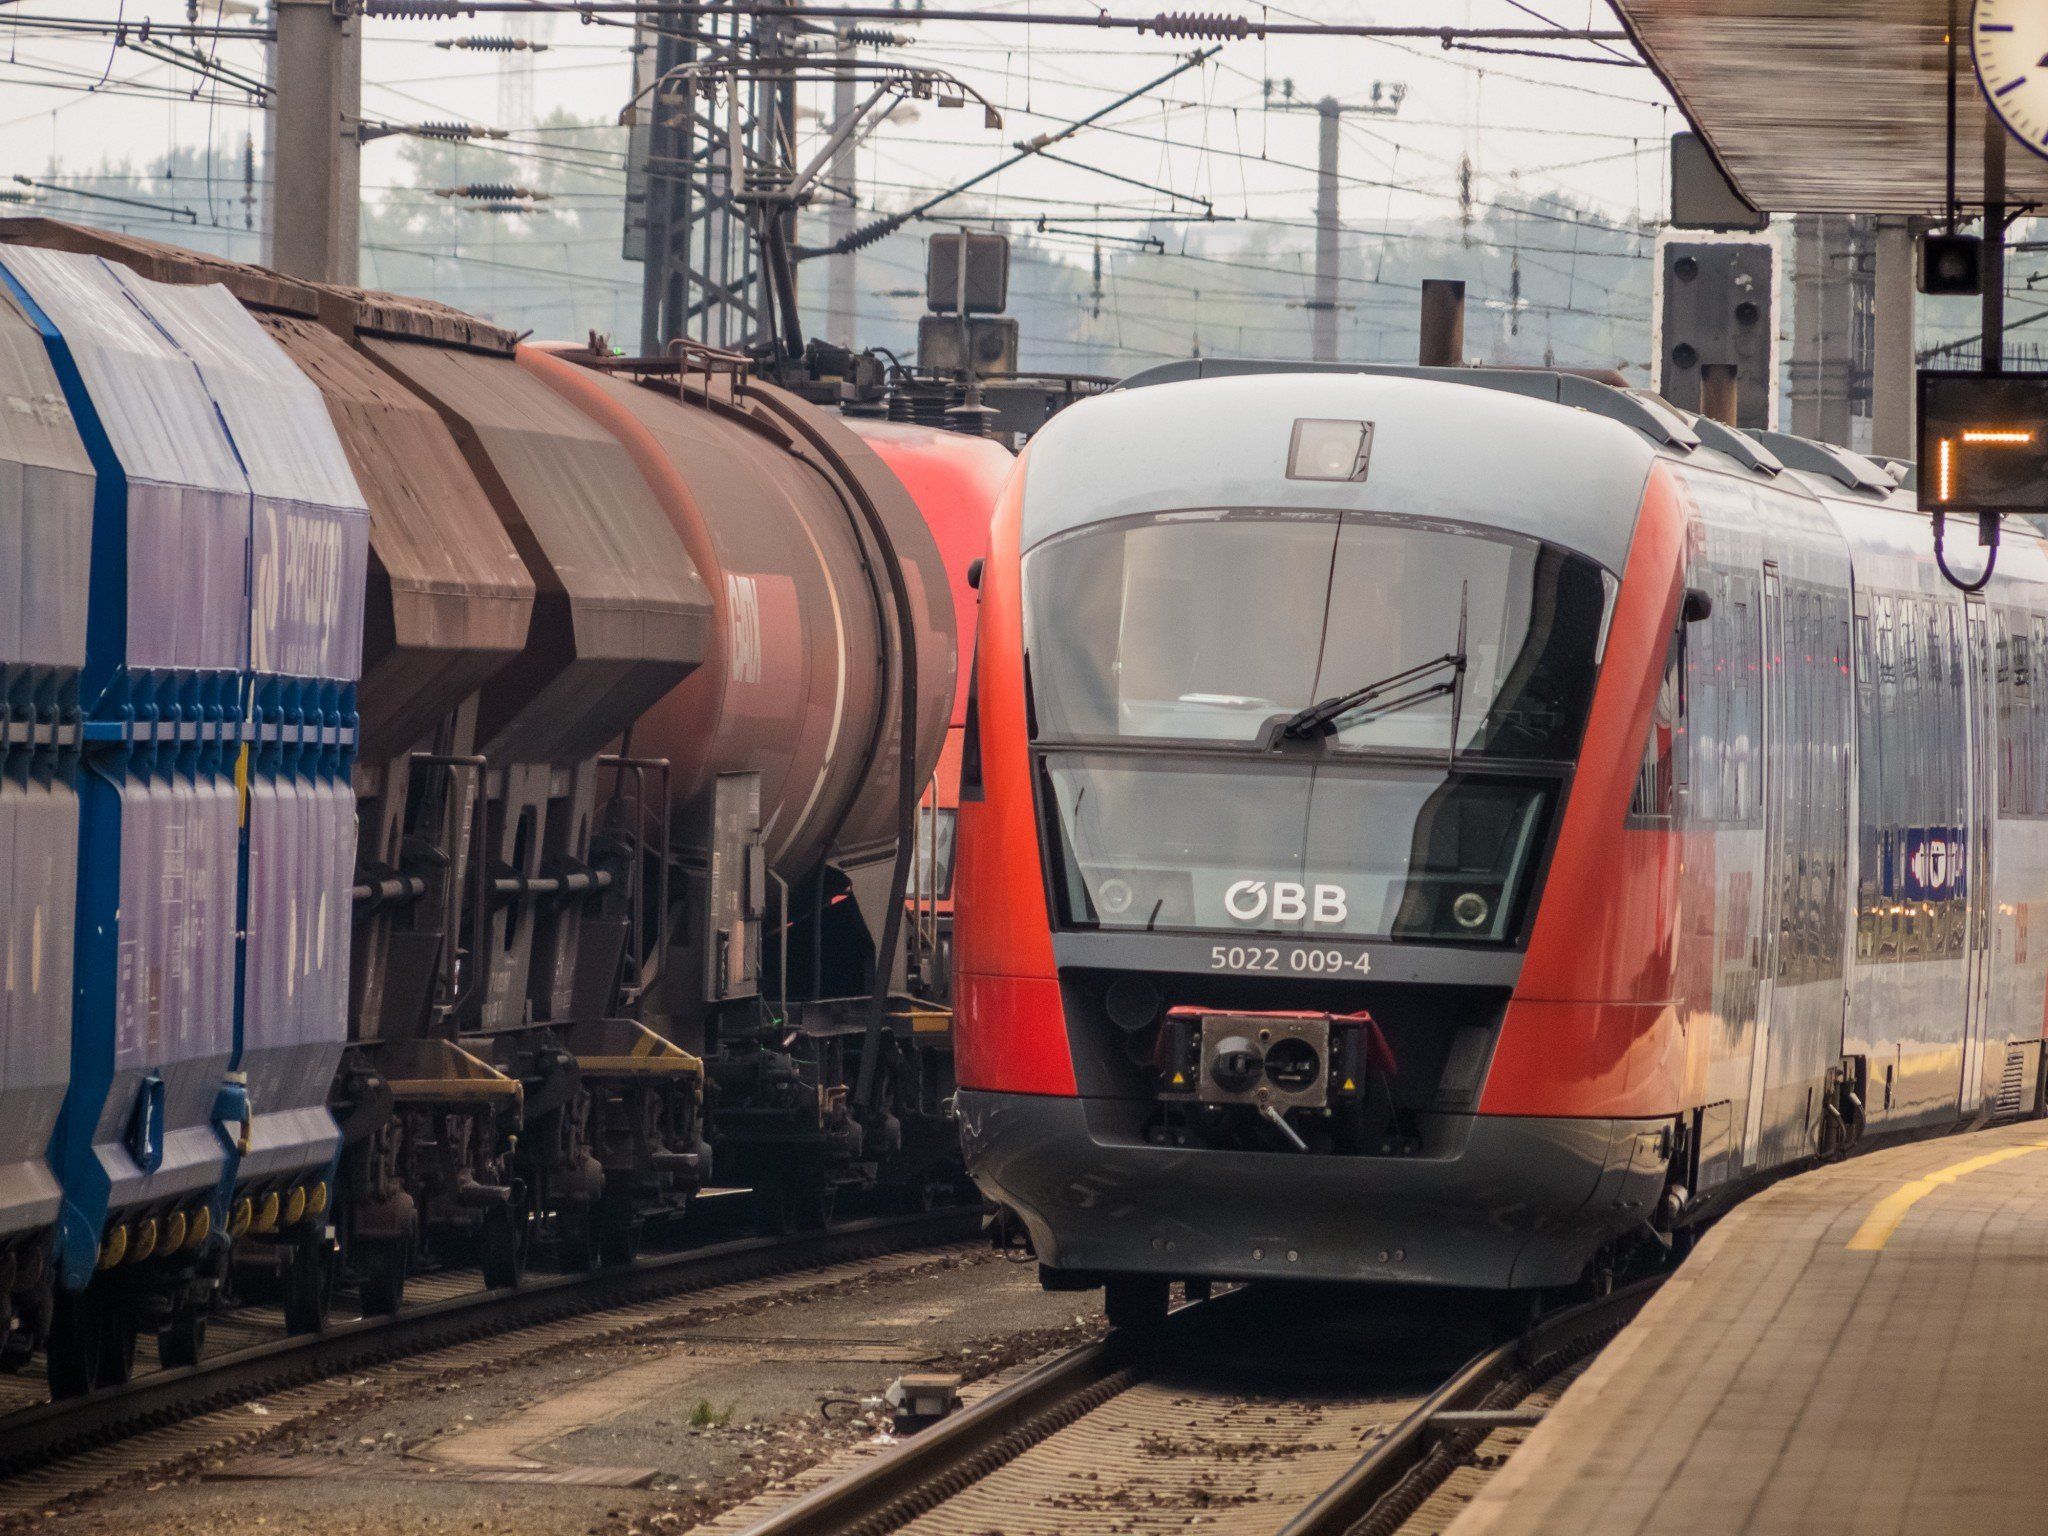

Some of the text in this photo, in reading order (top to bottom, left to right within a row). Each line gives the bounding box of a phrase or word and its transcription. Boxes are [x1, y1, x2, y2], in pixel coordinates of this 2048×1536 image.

[1224, 880, 1348, 923] ÖBB
[1211, 946, 1372, 975] 5022 009-4
